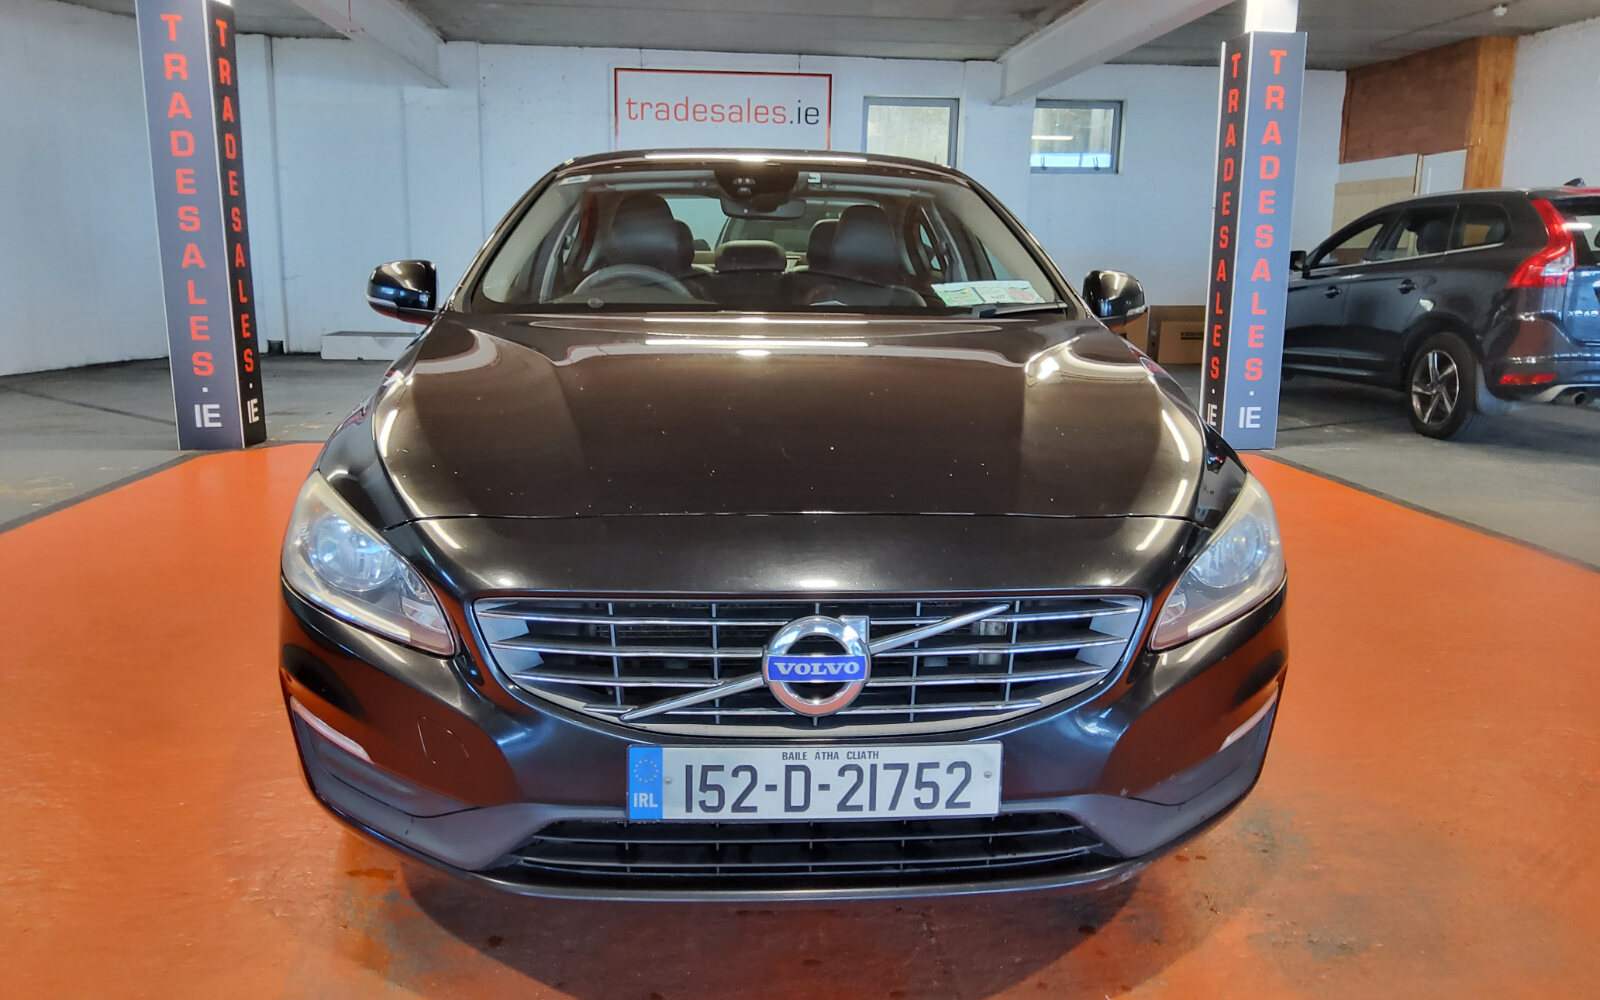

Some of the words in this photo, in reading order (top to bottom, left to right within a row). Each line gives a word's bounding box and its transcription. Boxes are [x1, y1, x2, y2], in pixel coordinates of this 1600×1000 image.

[625, 96, 820, 125] tradesales.ie
[773, 661, 860, 675] VOLVO
[782, 751, 808, 761] BAILE
[846, 750, 880, 760] CLIATH
[684, 760, 973, 814] 152-D-21752
[633, 792, 659, 808] IRL
